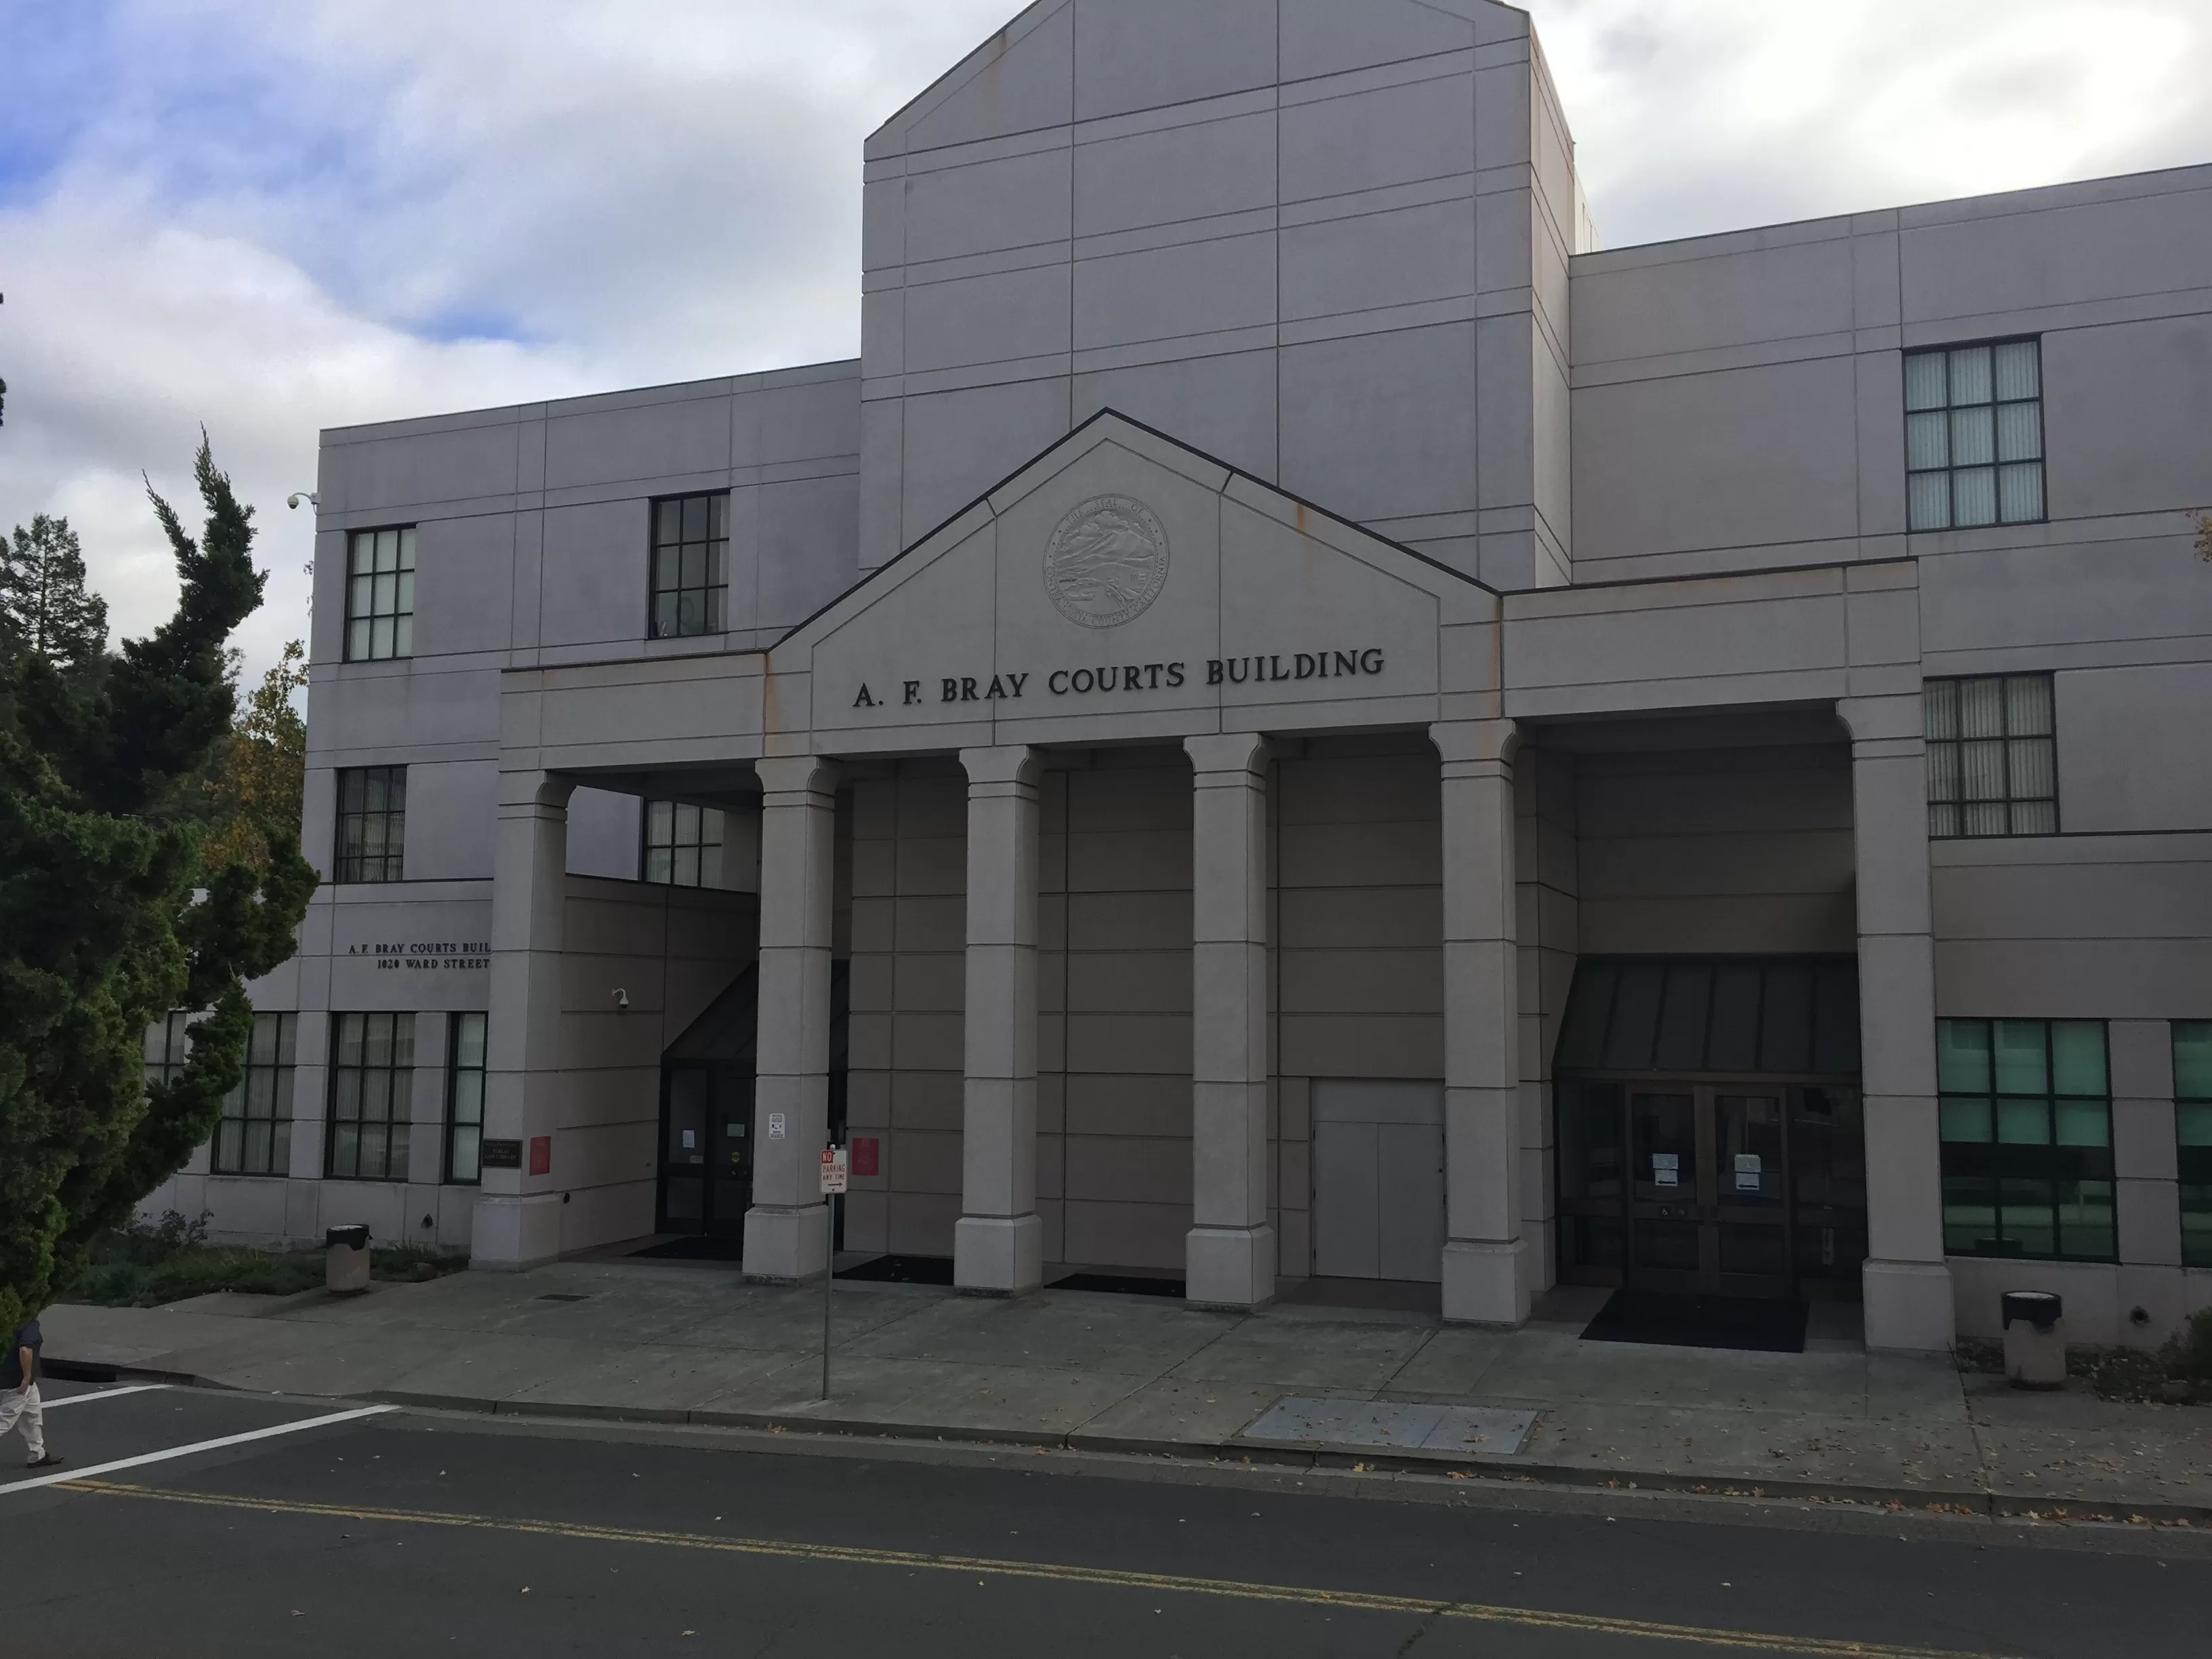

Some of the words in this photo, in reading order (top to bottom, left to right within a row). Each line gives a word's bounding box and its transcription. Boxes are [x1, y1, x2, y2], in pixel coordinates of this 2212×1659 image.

[1092, 611, 1131, 626] COUNTY
[852, 683, 884, 708] A.
[902, 680, 922, 705] F.
[941, 673, 1029, 703] BRAY
[1048, 662, 1186, 696] COURTS
[1206, 648, 1385, 686] BUILDING
[375, 943, 405, 954] BRAY
[410, 943, 457, 954] COURTS
[377, 959, 400, 970] 1020
[405, 959, 439, 970] WARD
[444, 959, 491, 970] STREET
[822, 1151, 832, 1162] NO
[823, 1164, 846, 1173] PARKING
